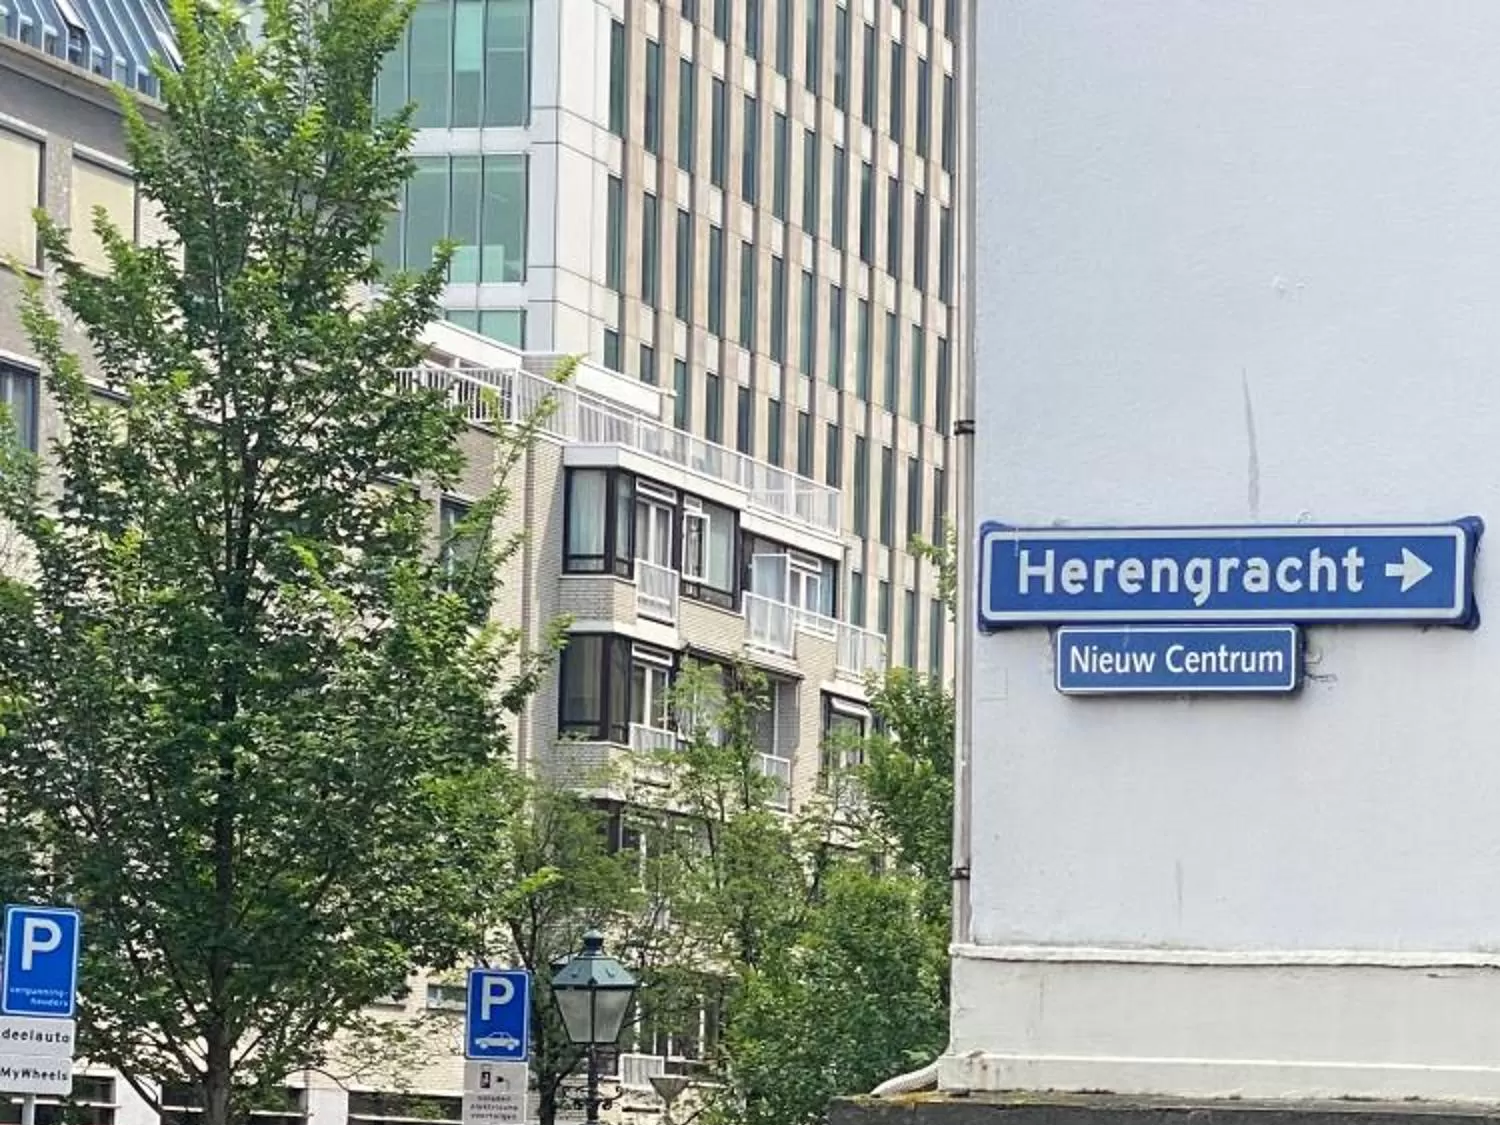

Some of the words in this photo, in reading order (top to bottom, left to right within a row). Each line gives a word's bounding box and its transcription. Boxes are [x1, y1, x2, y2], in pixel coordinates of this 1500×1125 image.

[1018, 547, 1365, 607] Herengracht
[1069, 645, 1156, 674] Nieuw
[1165, 644, 1285, 674] Centrum
[21, 917, 63, 971] P
[481, 976, 515, 1021] P
[1, 1027, 70, 1043] deelauto
[0, 1065, 68, 1081] MyWheels
